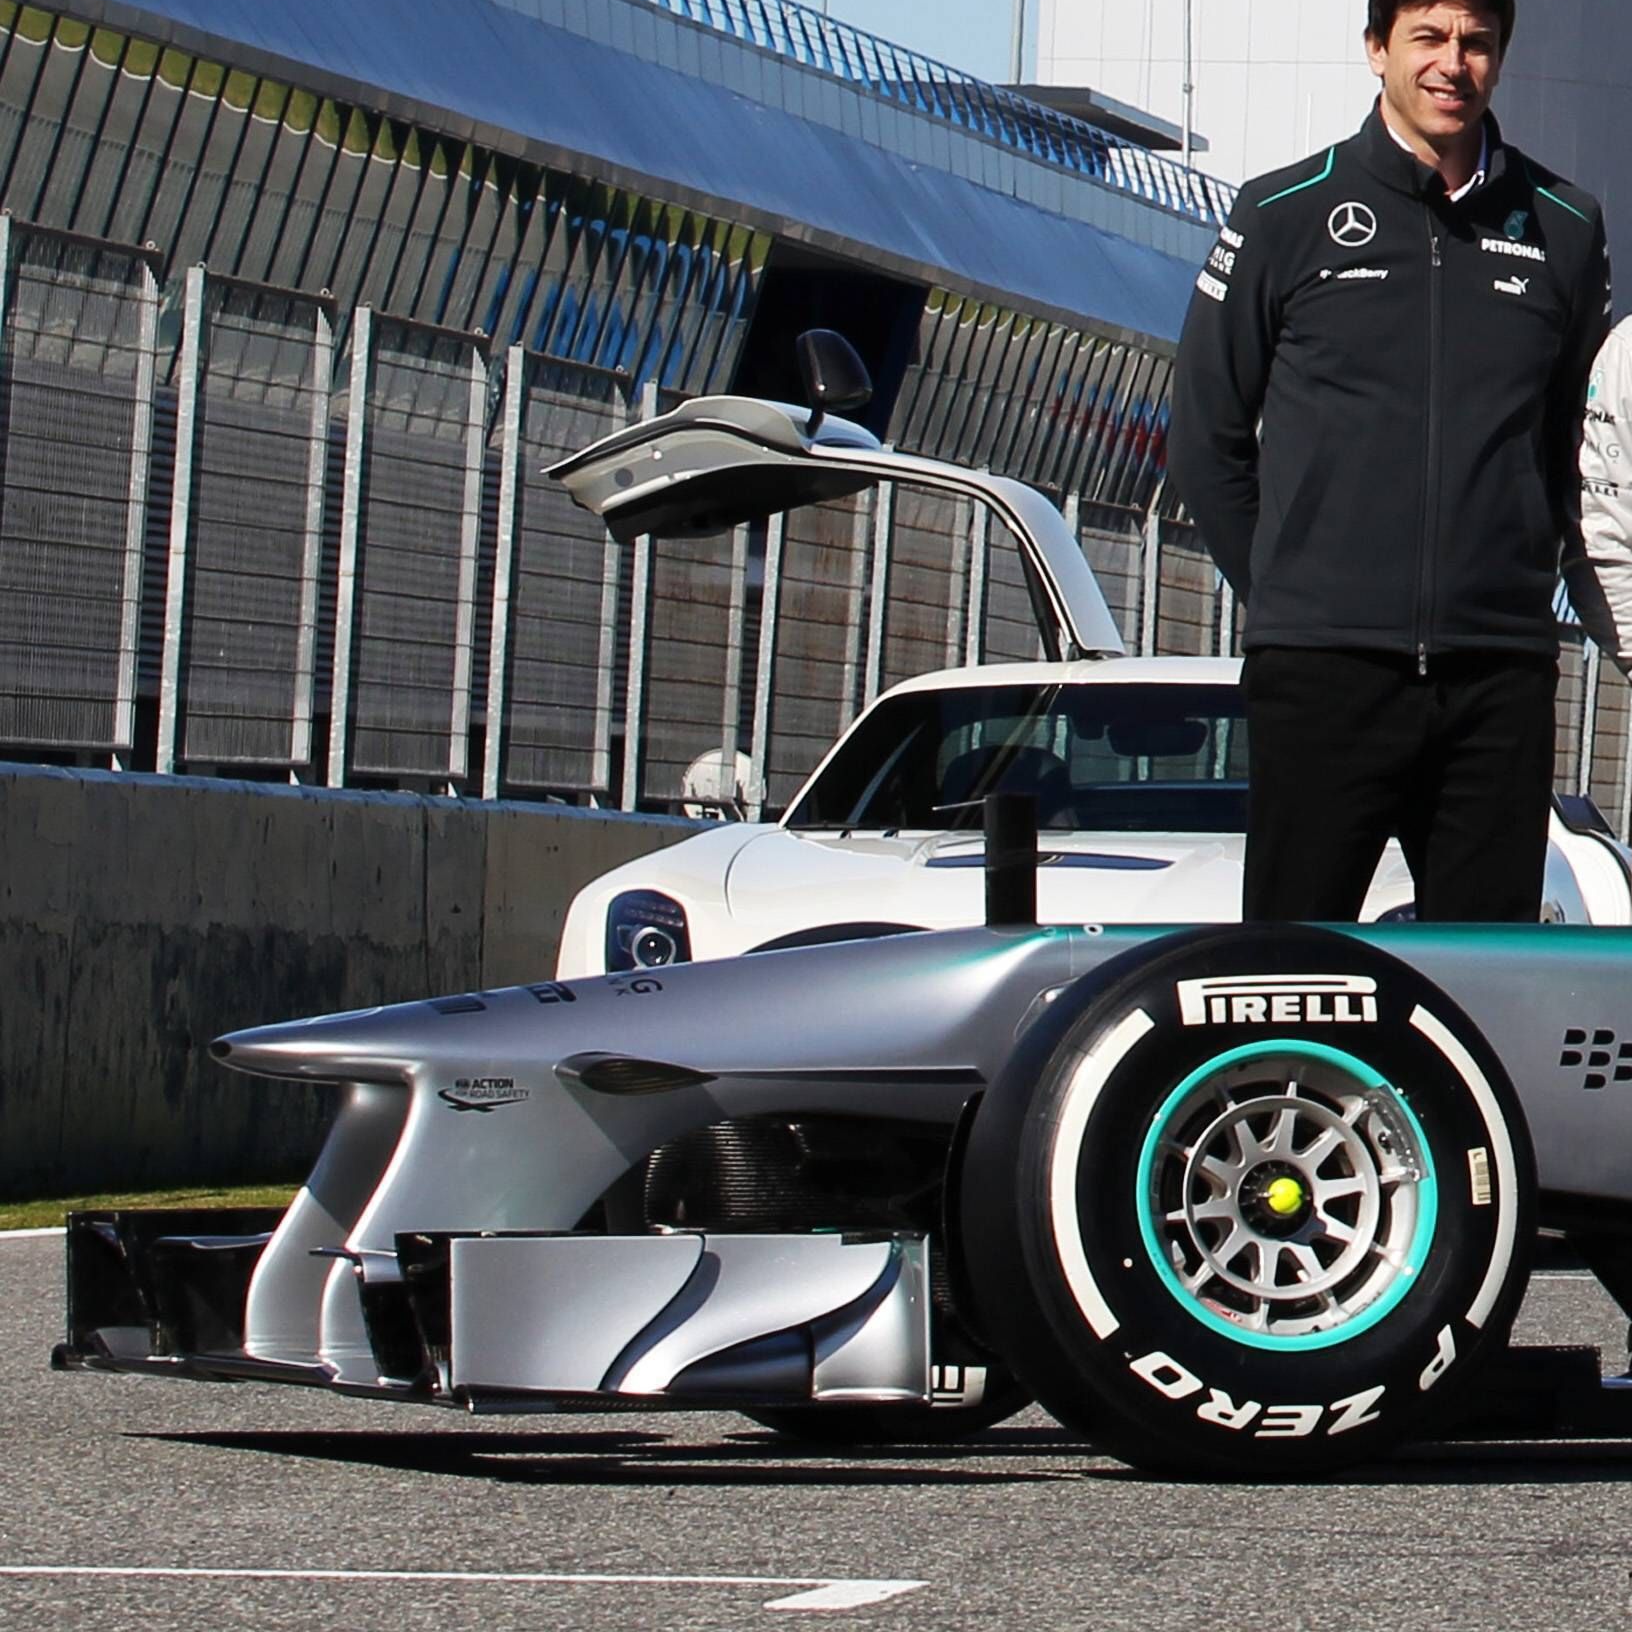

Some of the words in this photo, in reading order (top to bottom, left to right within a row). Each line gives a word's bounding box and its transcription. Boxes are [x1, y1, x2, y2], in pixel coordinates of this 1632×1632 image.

[1177, 974, 1378, 1026] PIRELLI
[472, 1078, 514, 1088] ACTION
[1418, 1323, 1457, 1392] P
[1129, 1350, 1386, 1438] ZERO
